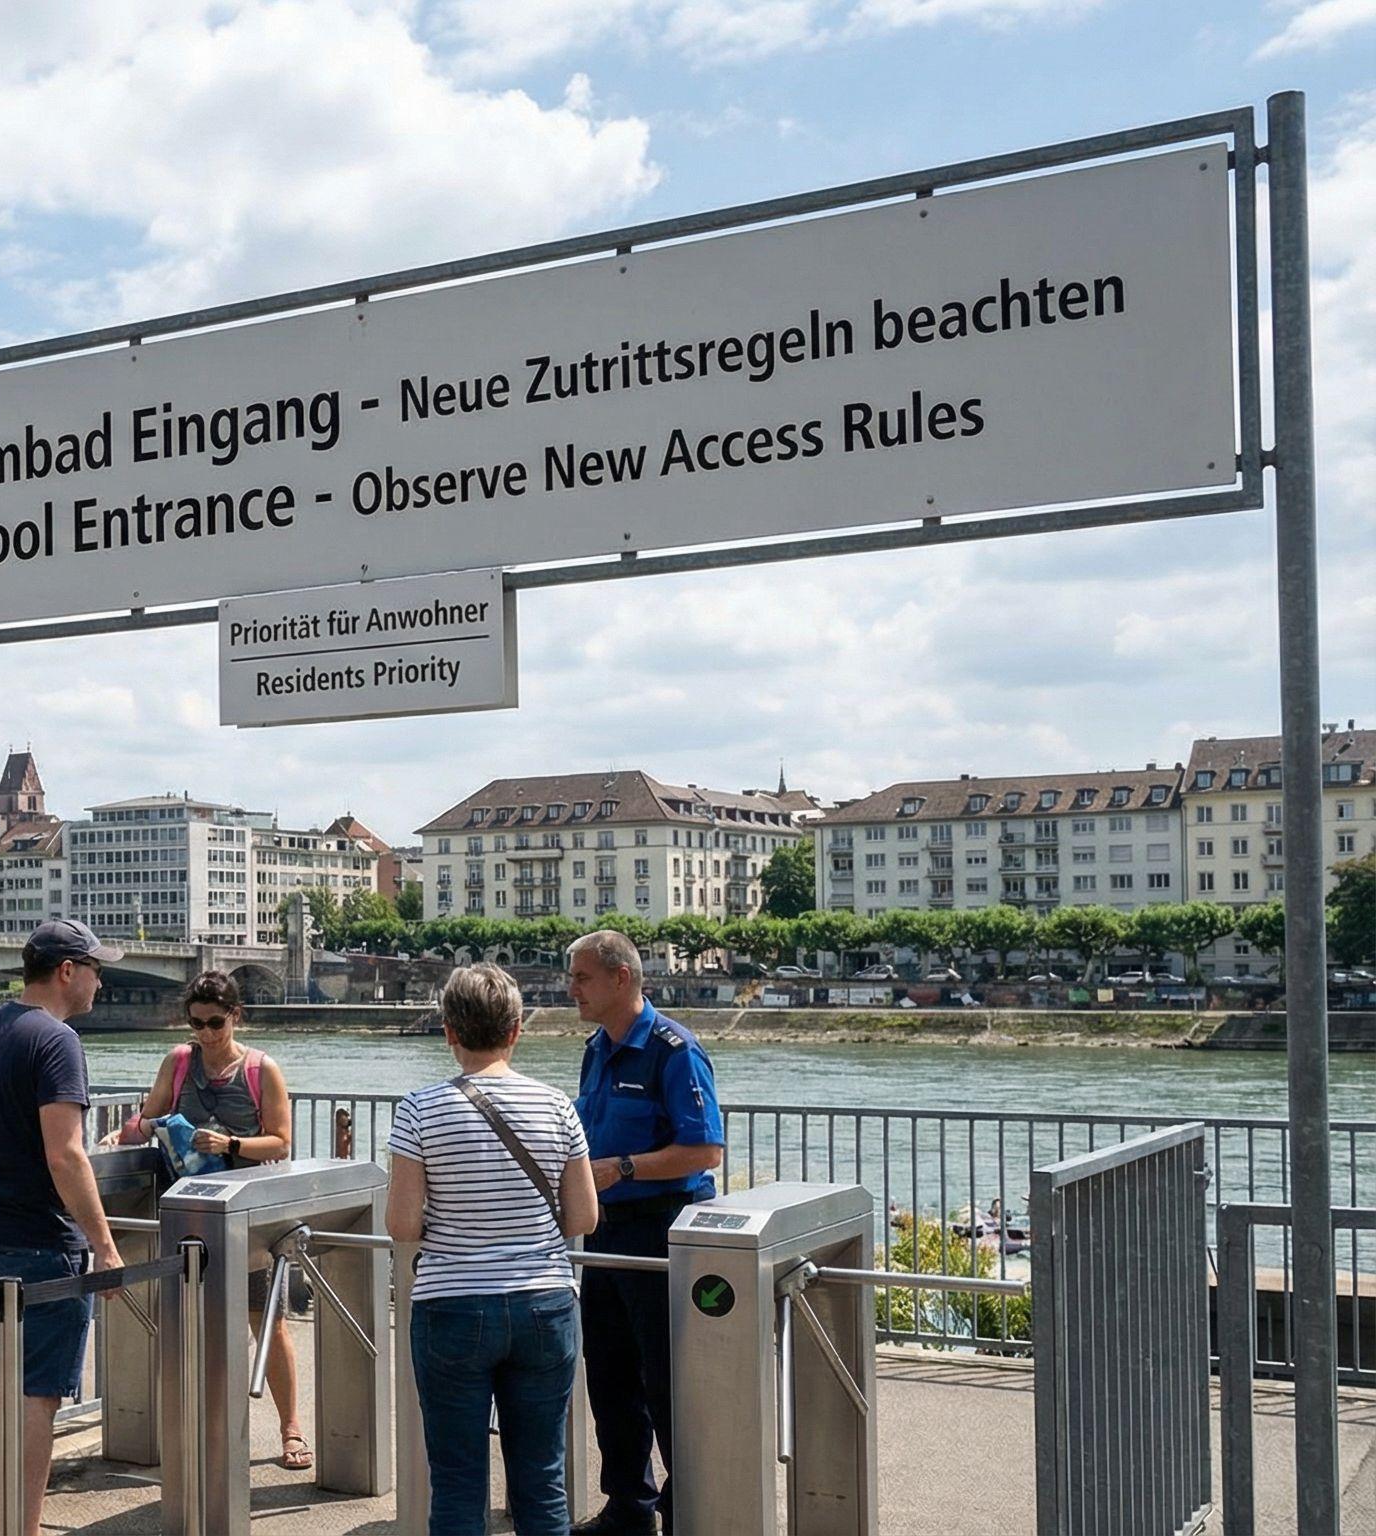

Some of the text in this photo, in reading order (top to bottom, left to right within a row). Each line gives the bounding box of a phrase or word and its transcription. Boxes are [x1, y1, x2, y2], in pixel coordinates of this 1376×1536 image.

[132, 390, 340, 467] Eingang
[400, 374, 510, 423] Neue
[525, 309, 854, 404] Zutrittsregeln
[873, 275, 1125, 351] beachten
[73, 485, 295, 553] Entrance
[352, 462, 528, 516] Observe
[544, 443, 647, 492] New
[659, 420, 824, 477] Access
[843, 390, 985, 453] Rules
[230, 598, 489, 647] Priorität für Anwohner
[256, 655, 461, 697] Residents Priority
